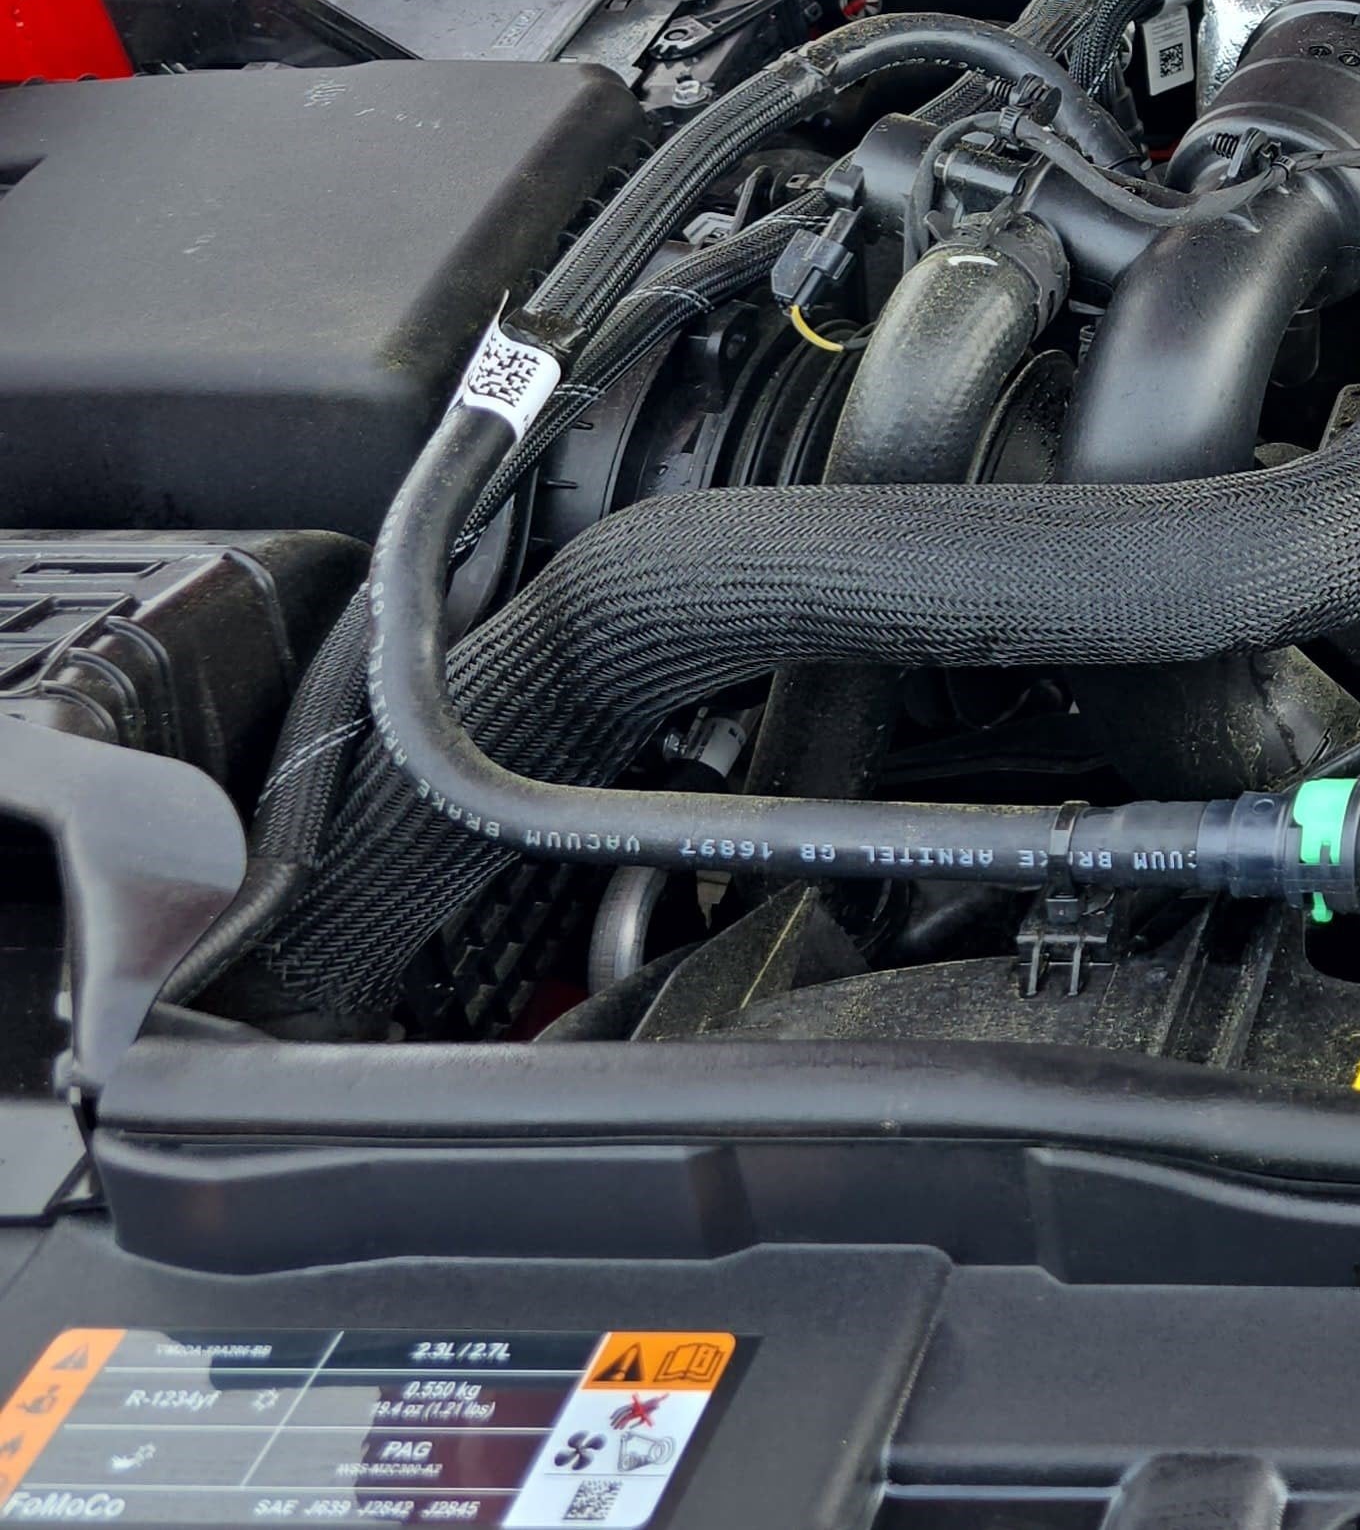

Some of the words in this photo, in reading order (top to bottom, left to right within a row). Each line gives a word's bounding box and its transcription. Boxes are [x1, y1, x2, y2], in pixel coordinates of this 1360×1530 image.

[415, 777, 501, 838] BRAKE
[524, 828, 641, 853] VACUUM
[678, 837, 774, 858] 16897
[801, 843, 836, 864] GB
[860, 844, 994, 867] ARNITEL
[411, 1341, 455, 1360] 2.3L
[468, 1342, 511, 1361] 2.7L
[126, 1389, 222, 1412] R-1234yf
[403, 1381, 455, 1399] 0.550
[456, 1381, 481, 1401] kg
[371, 1401, 403, 1417] 19.4
[404, 1403, 424, 1416] oz
[464, 1401, 496, 1419] lbs)
[381, 1441, 433, 1459] PAG
[3, 1491, 126, 1518] FoMoCo
[254, 1499, 298, 1516] SAE
[357, 1500, 415, 1518] J2842
[421, 1500, 481, 1518] J2845
